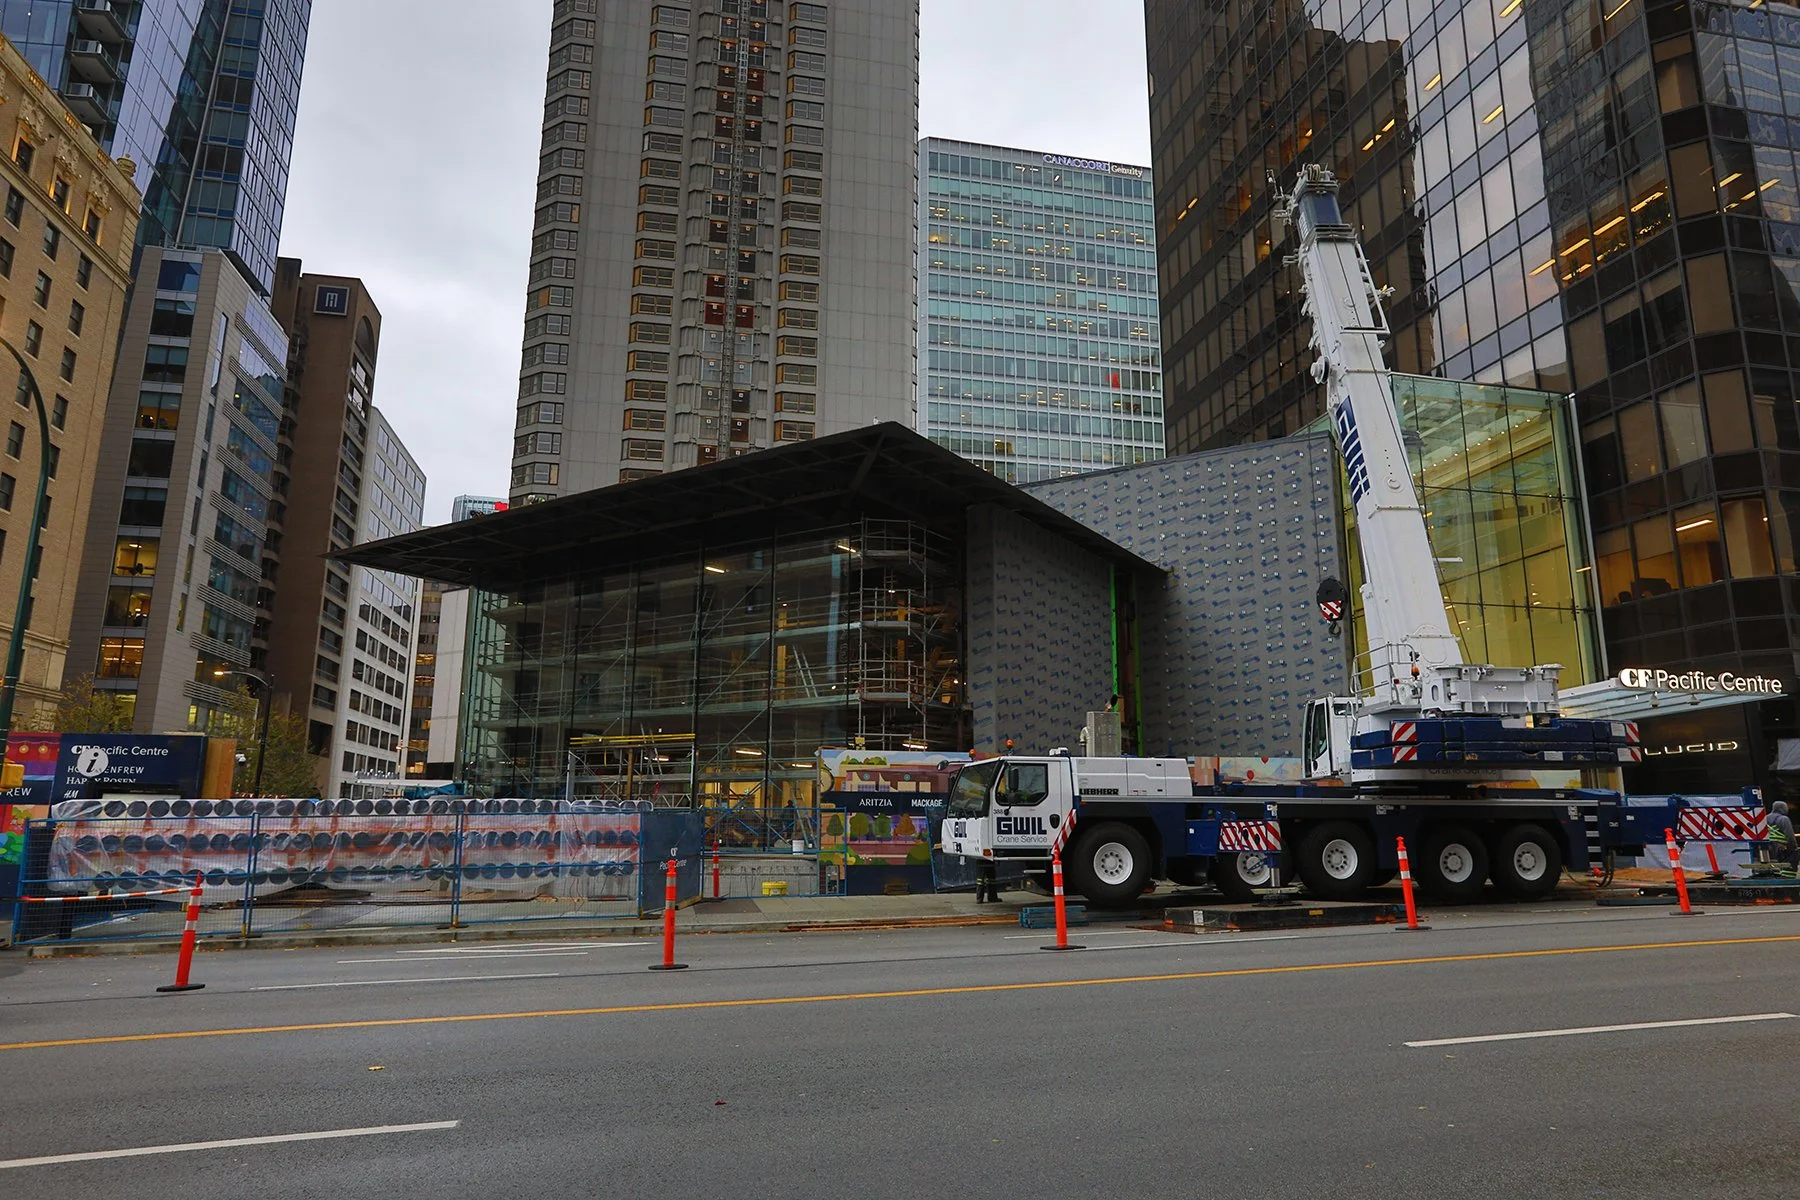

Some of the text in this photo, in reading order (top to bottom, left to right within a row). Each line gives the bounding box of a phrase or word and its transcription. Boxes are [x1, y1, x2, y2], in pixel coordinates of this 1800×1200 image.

[1042, 154, 1143, 178] CANACCORD Genuity
[1619, 668, 1783, 694] CF Pacific Centre
[131, 745, 169, 757] Centre
[1644, 741, 1738, 756] LUCID
[1079, 788, 1119, 796] LIEBHERR
[859, 798, 893, 807] ARITZIA
[911, 799, 943, 808] MACKAGE
[996, 817, 1047, 835] GWIL
[997, 835, 1048, 843] Crane Service
